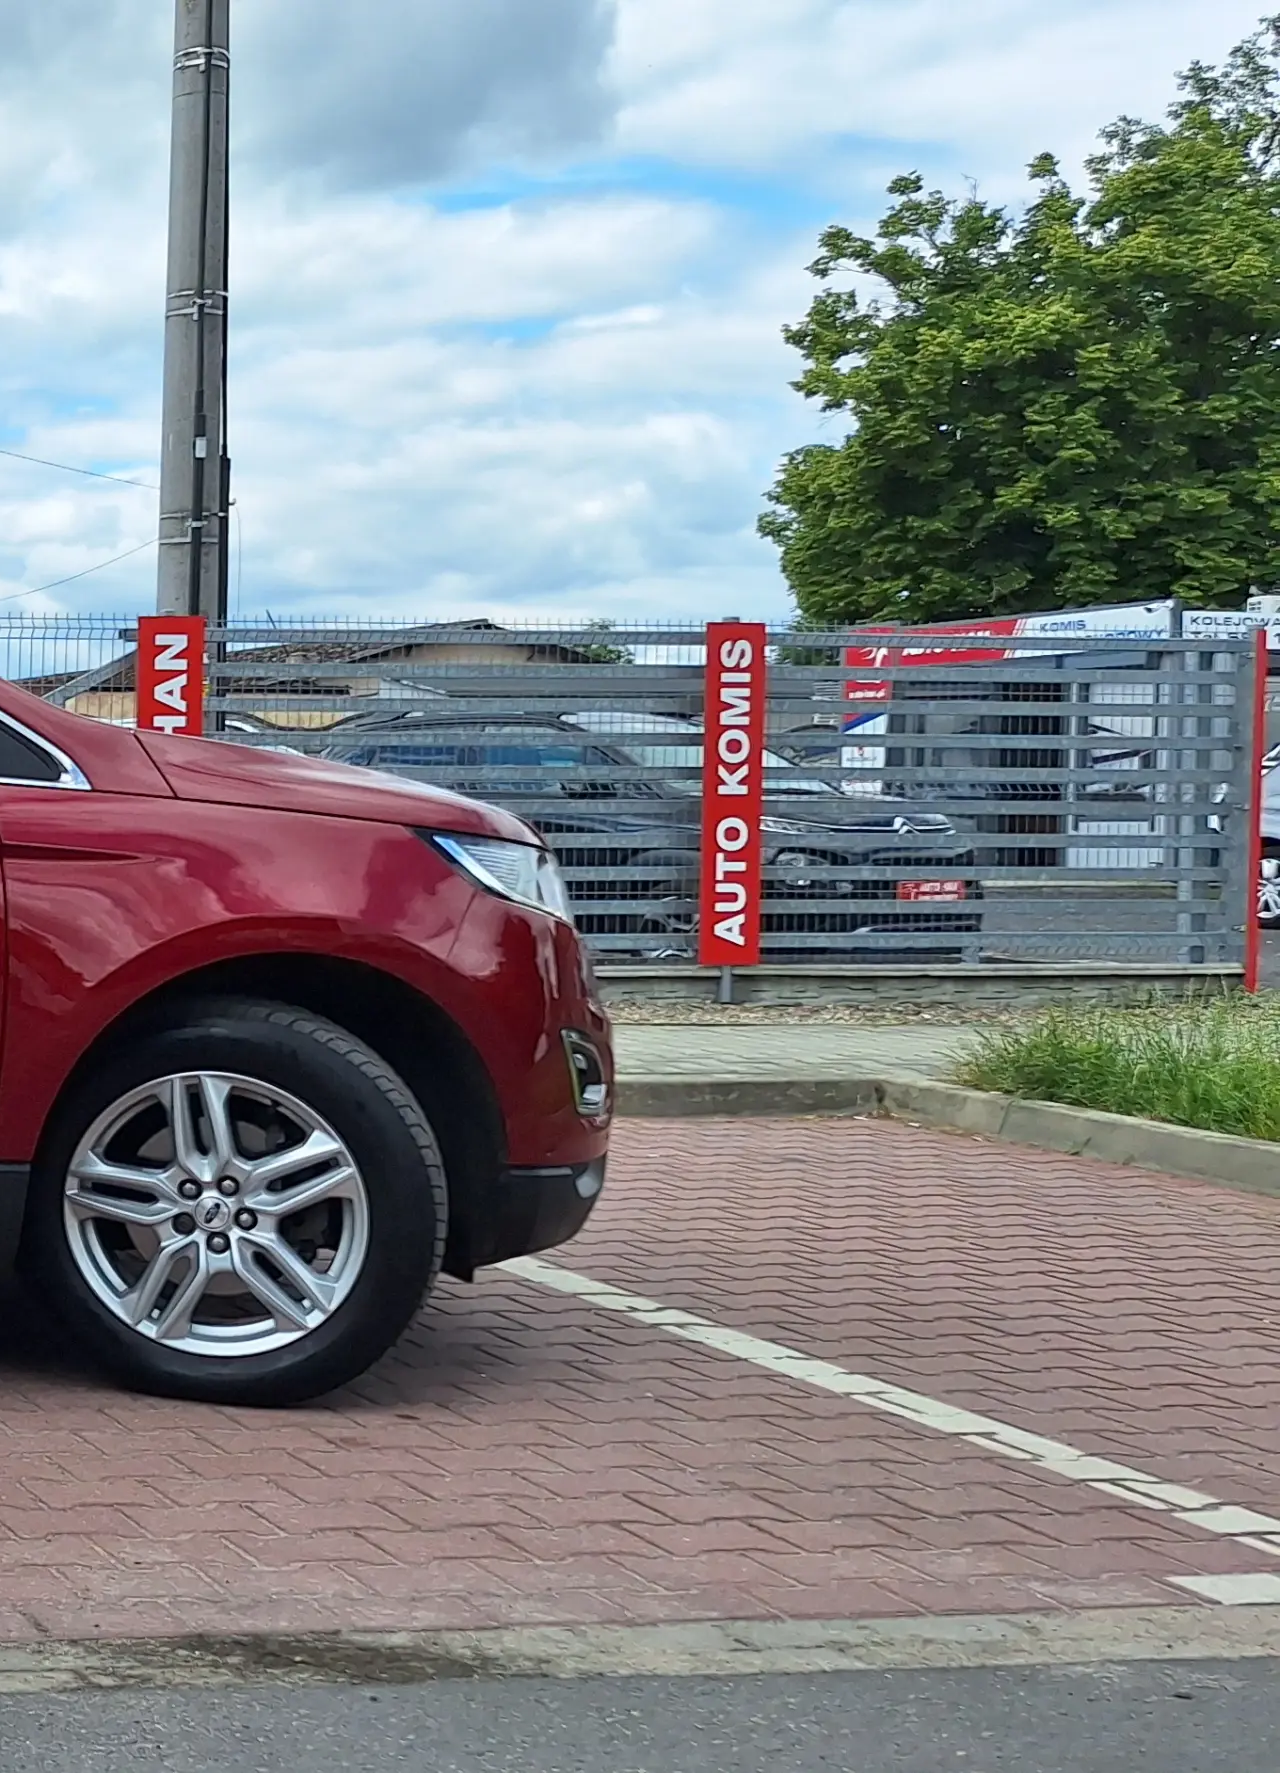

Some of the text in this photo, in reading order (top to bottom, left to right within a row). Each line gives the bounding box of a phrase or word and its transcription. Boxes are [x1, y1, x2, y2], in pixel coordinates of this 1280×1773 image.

[1040, 620, 1086, 633] KOMIS
[713, 639, 753, 946] AUTO KOMIS
